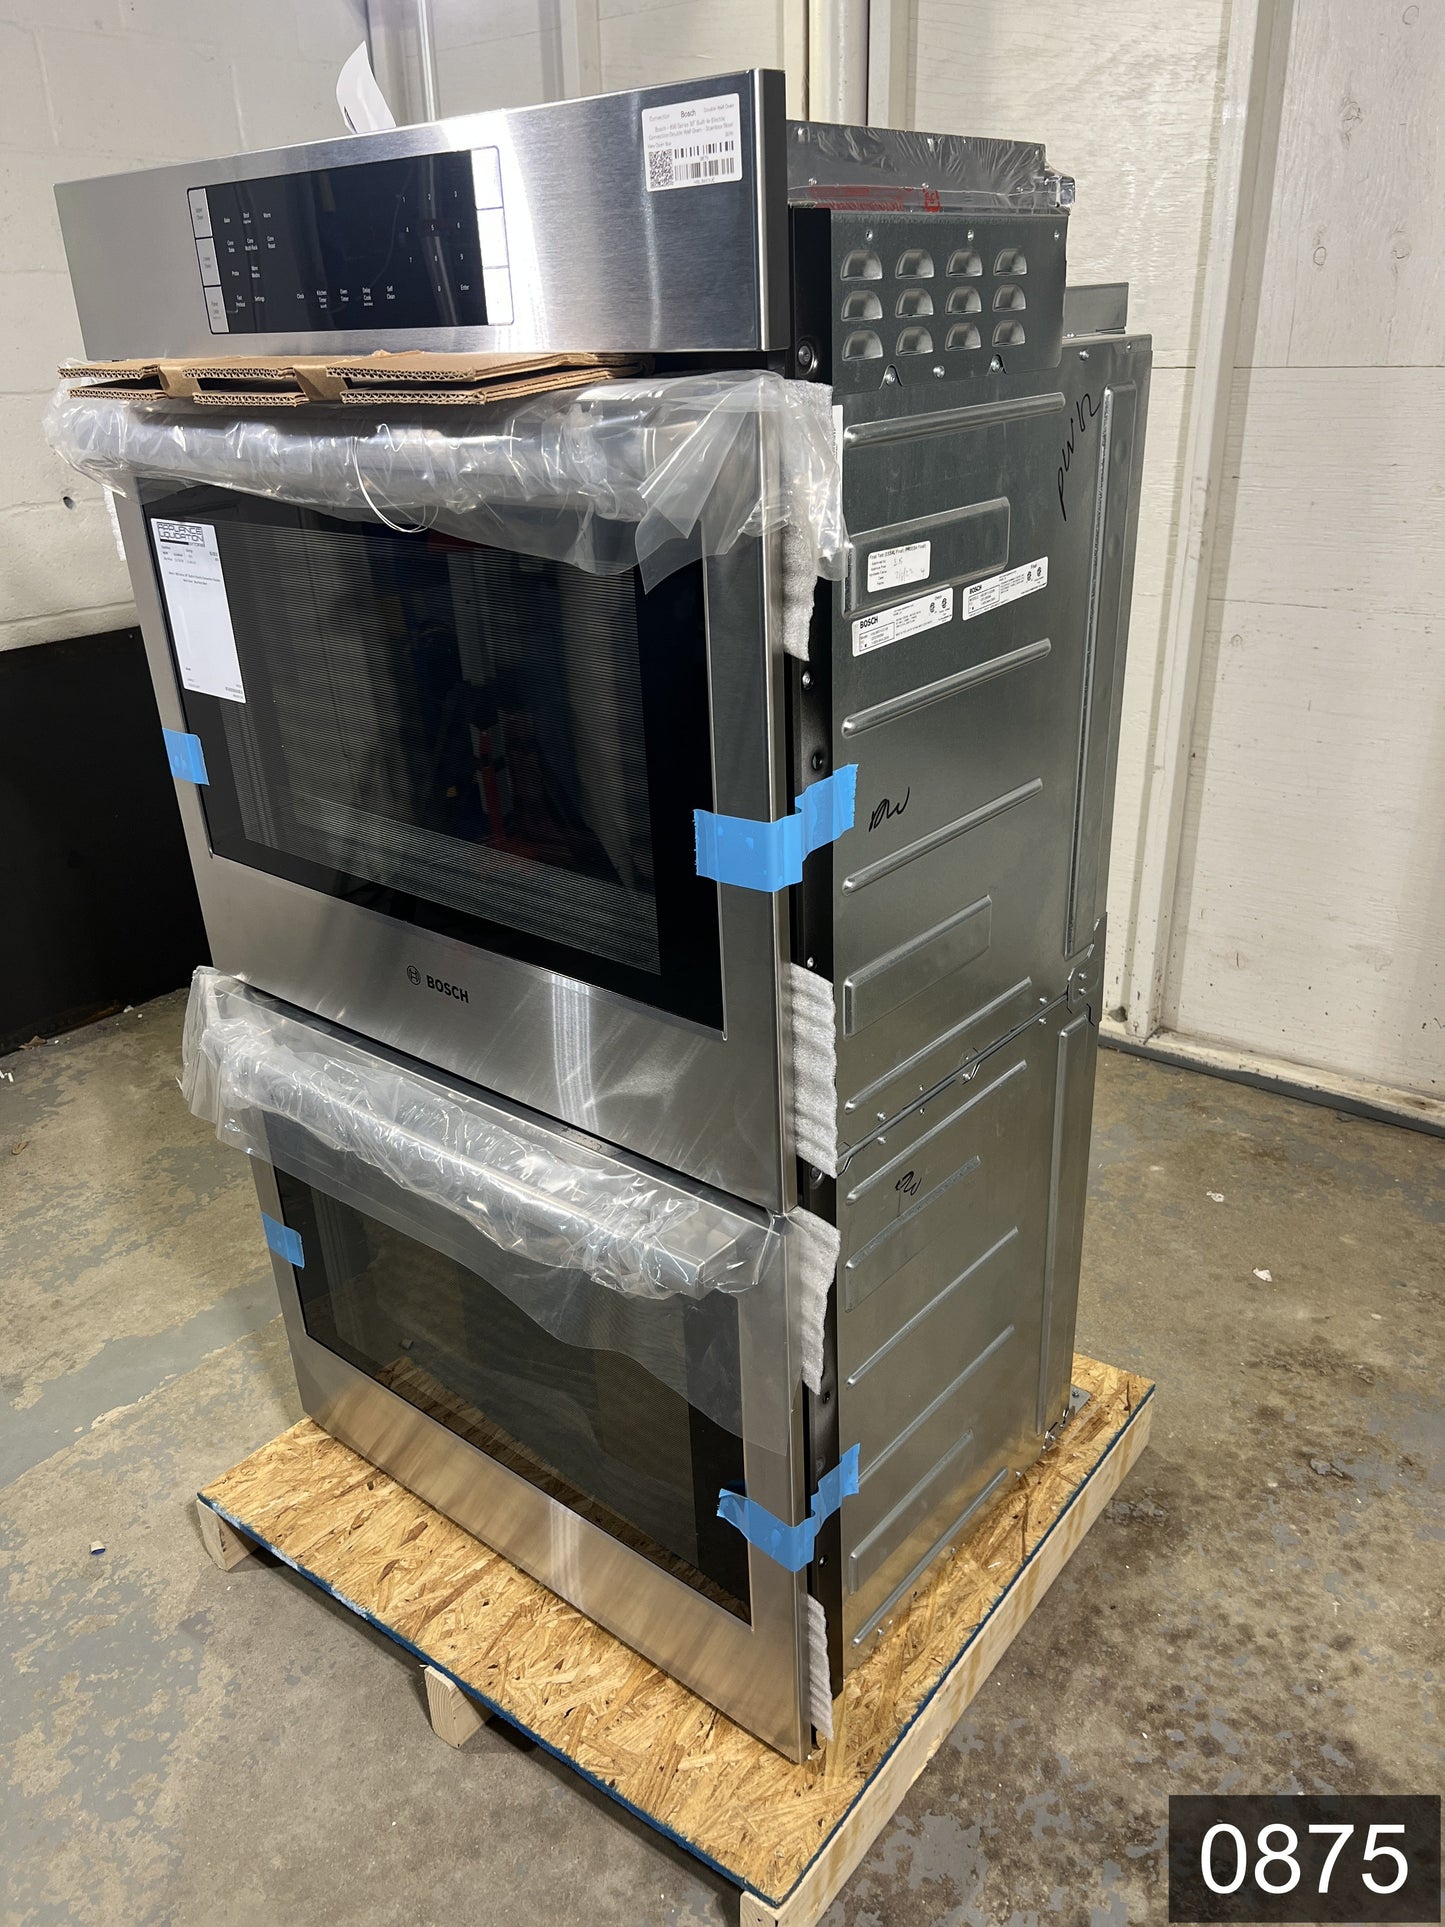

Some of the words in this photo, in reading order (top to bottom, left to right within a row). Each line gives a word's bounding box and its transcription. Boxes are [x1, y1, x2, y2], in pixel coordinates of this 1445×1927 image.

[680, 109, 696, 118] Bosch
[158, 523, 202, 535] APPLIANCE
[159, 531, 204, 542] LIQUIDATION
[969, 585, 982, 594] BOSCH
[860, 616, 878, 628] BOSCH
[426, 974, 469, 1004] BOSCH
